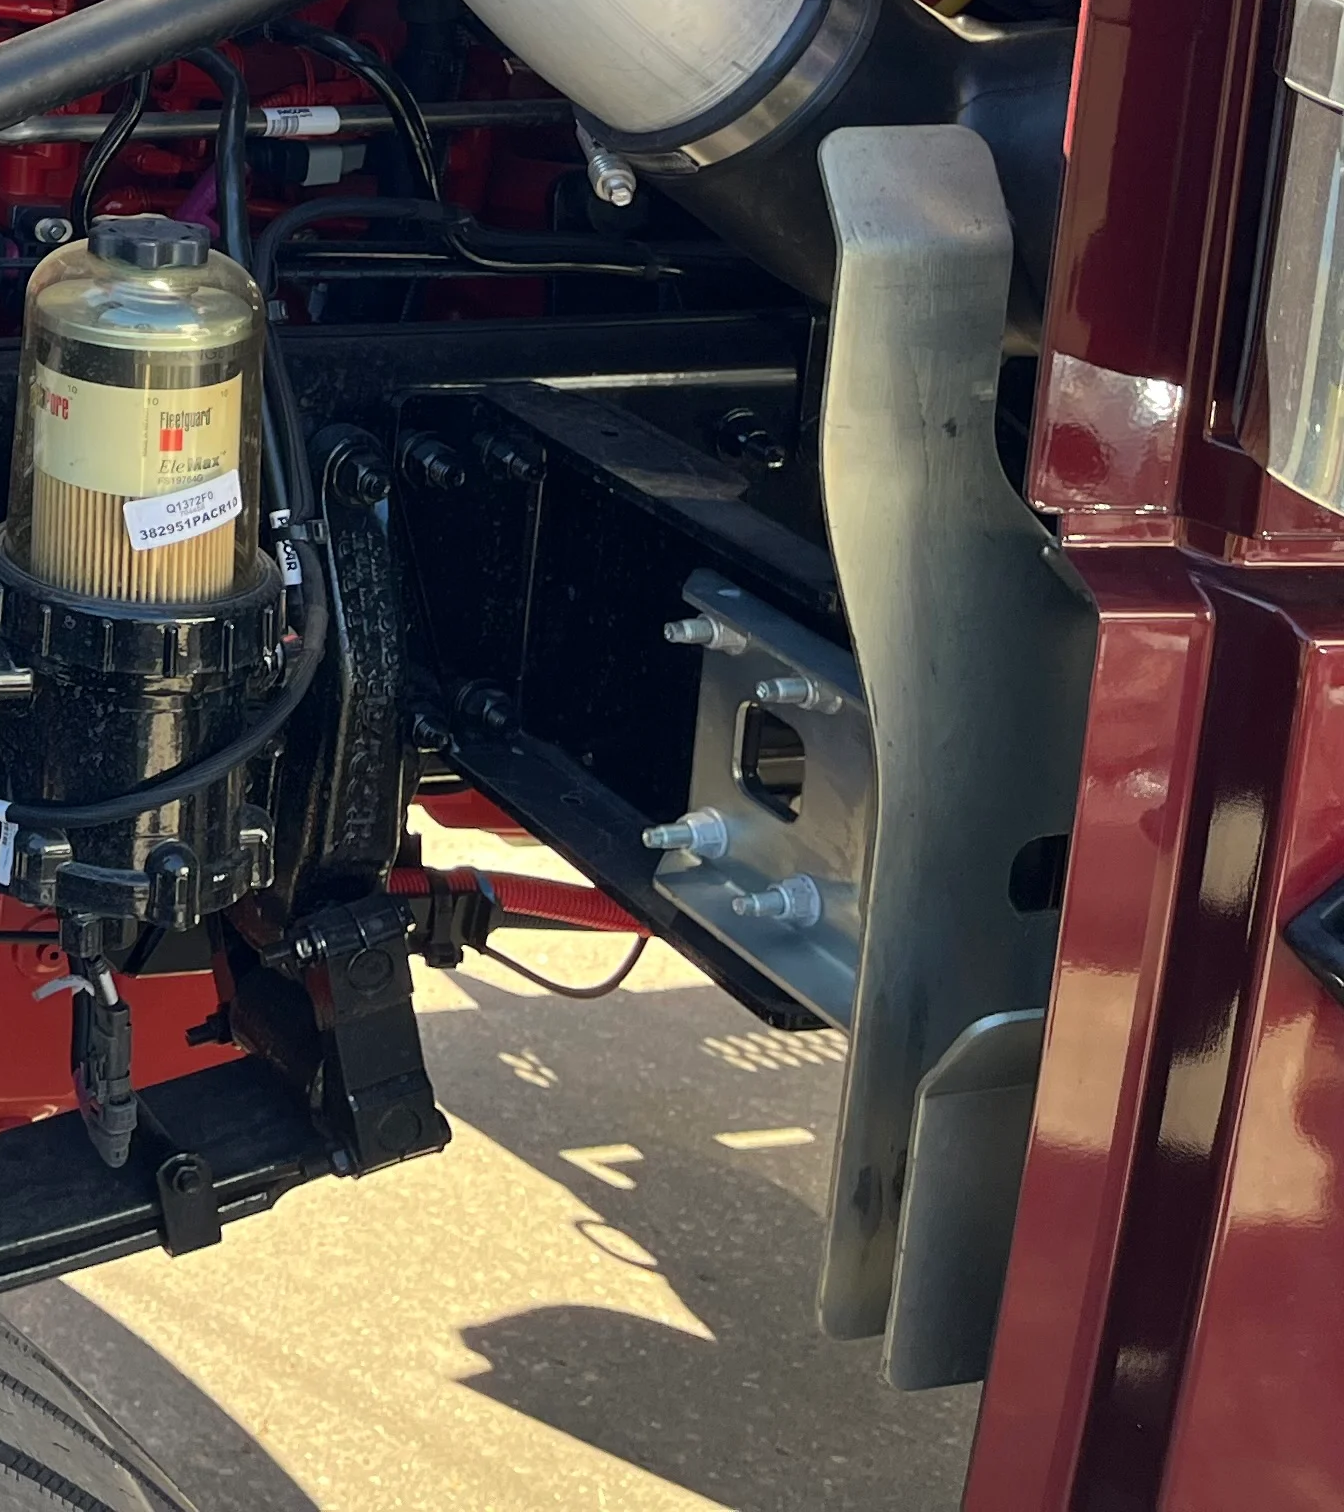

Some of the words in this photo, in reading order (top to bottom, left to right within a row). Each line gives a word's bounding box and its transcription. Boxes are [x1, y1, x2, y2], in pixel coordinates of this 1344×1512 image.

[160, 407, 212, 432] Fleetguard
[166, 491, 214, 515] Q1372F0
[139, 496, 239, 540] 382951PACR10
